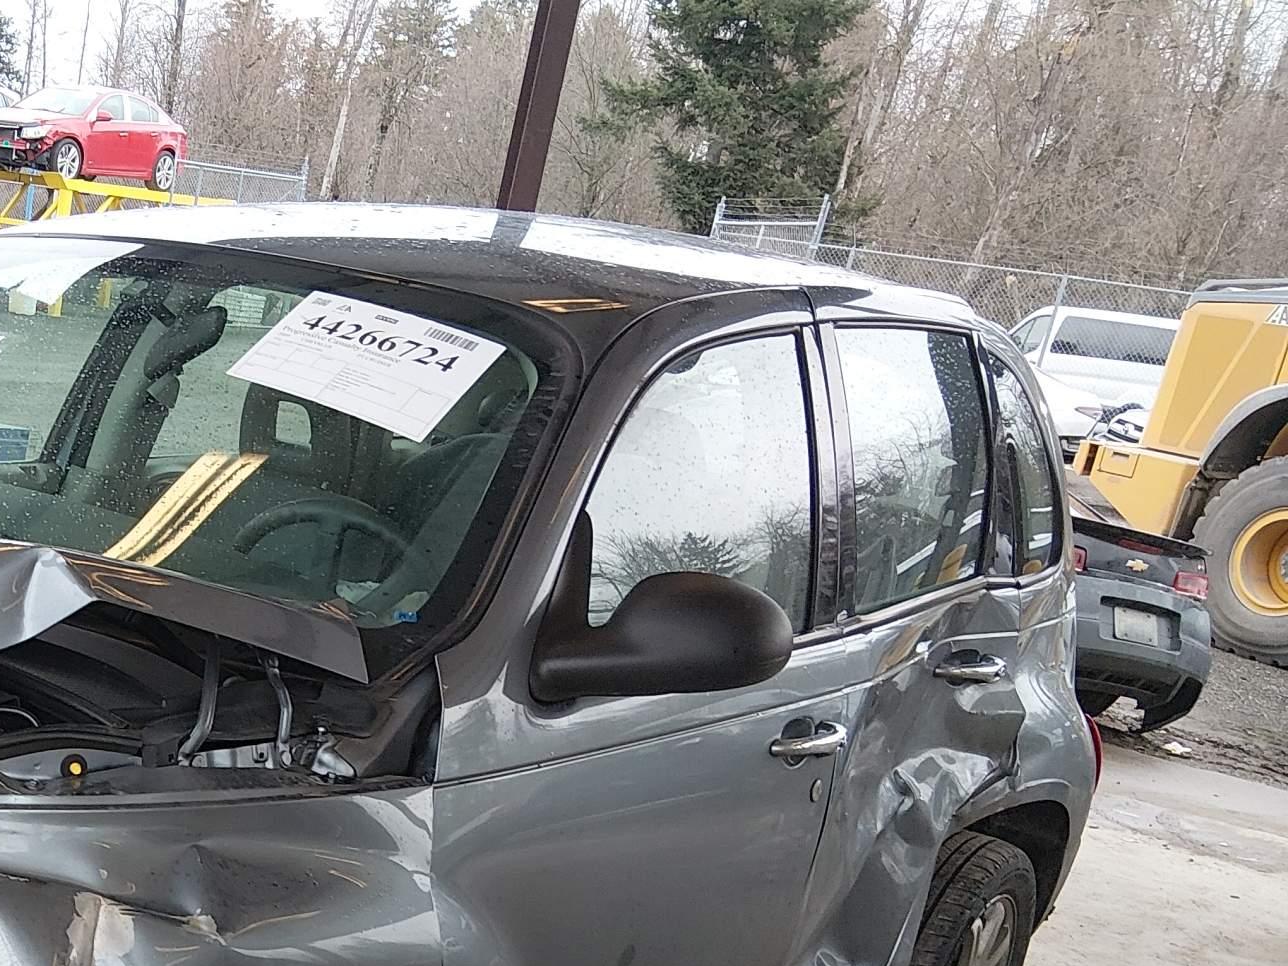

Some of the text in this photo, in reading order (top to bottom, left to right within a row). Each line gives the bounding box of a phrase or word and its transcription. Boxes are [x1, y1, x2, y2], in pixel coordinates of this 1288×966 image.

[282, 325, 327, 341] Progressive
[327, 338, 360, 351] Casualty
[362, 347, 401, 364] Insurance
[303, 315, 460, 372] 44266724
